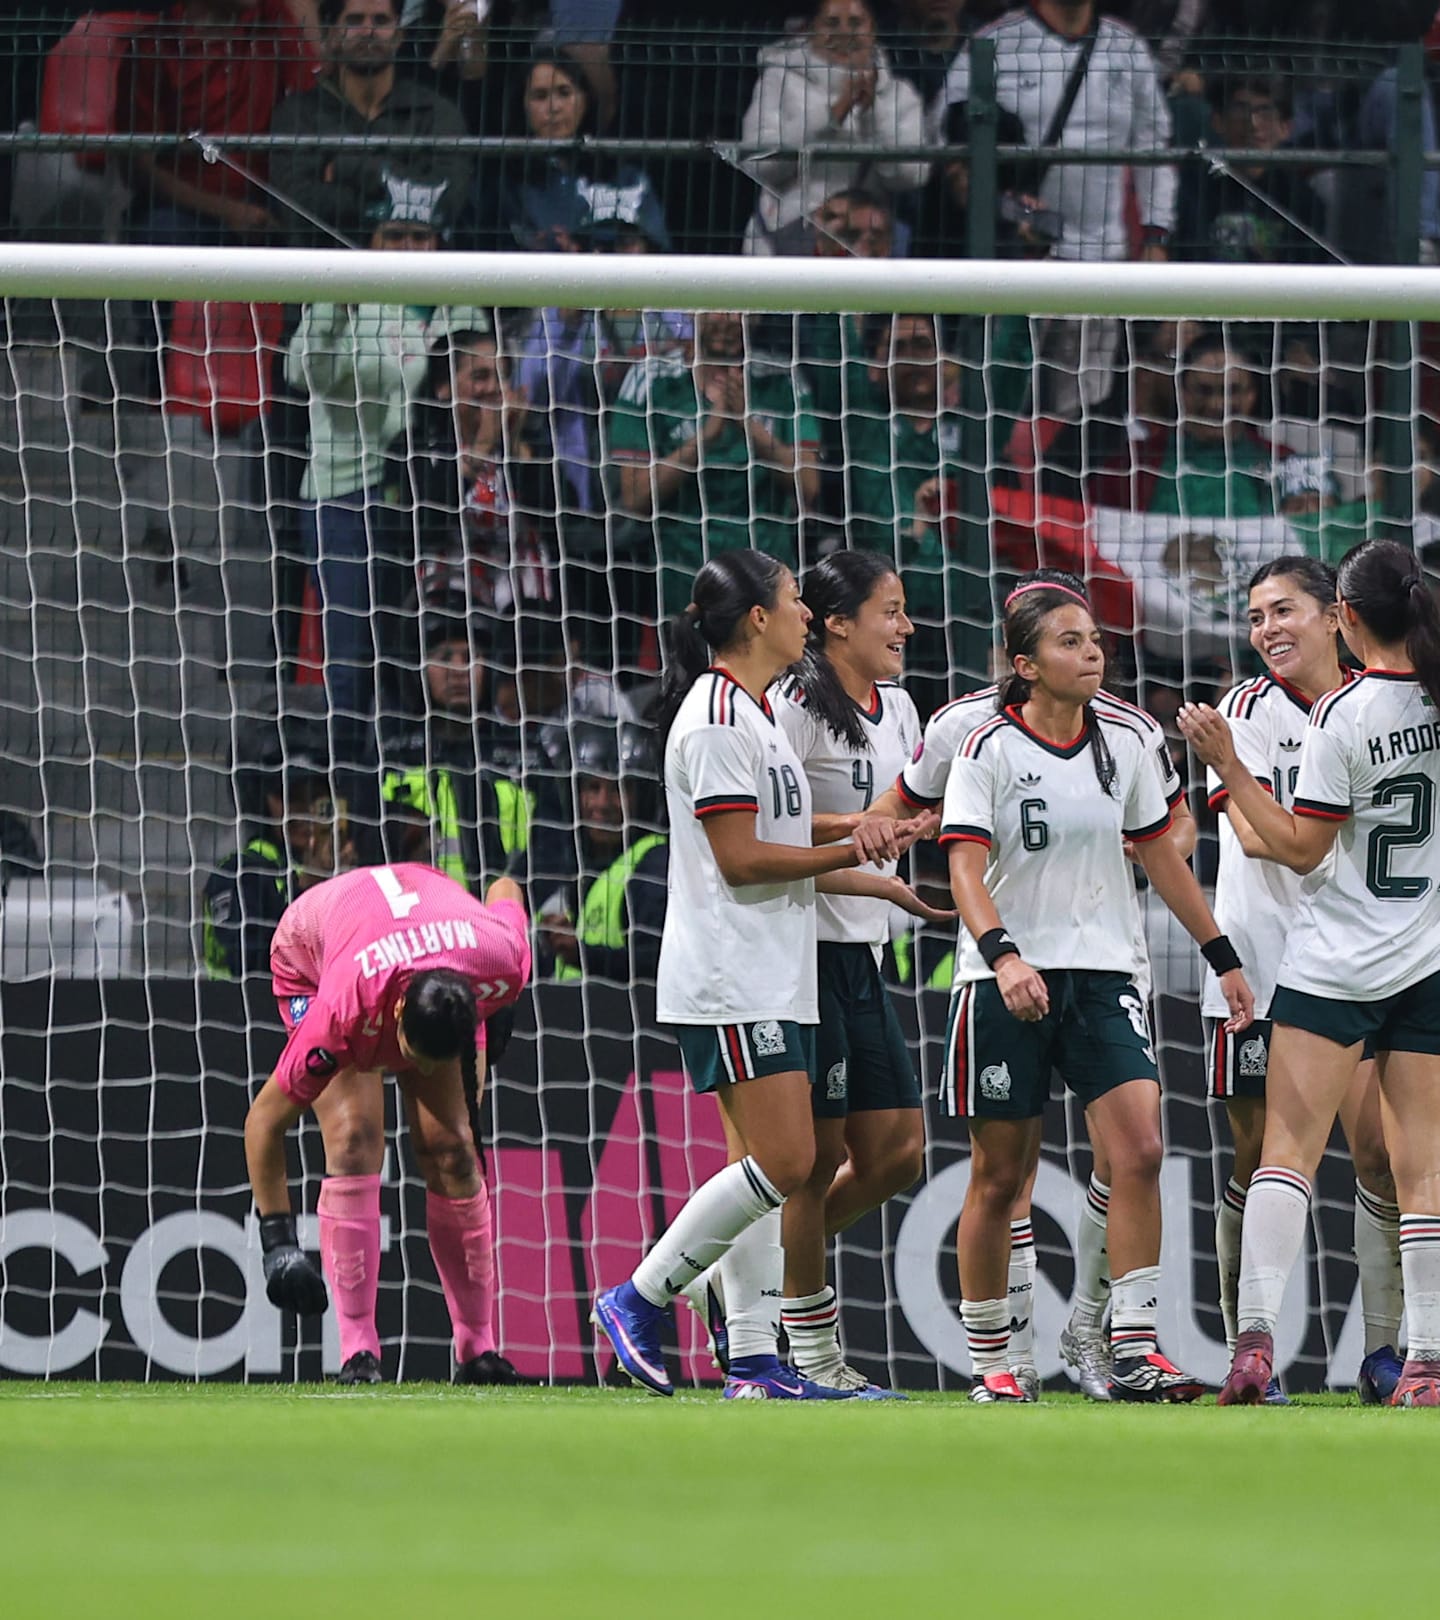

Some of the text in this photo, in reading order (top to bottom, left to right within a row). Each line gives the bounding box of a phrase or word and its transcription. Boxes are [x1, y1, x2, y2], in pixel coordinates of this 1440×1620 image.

[768, 764, 801, 819] 18
[852, 759, 873, 810] 4
[1020, 798, 1048, 851] 6
[370, 867, 421, 920] 1
[353, 918, 479, 980] MARTÍNEZ
[1008, 1282, 1033, 1294] XICO
